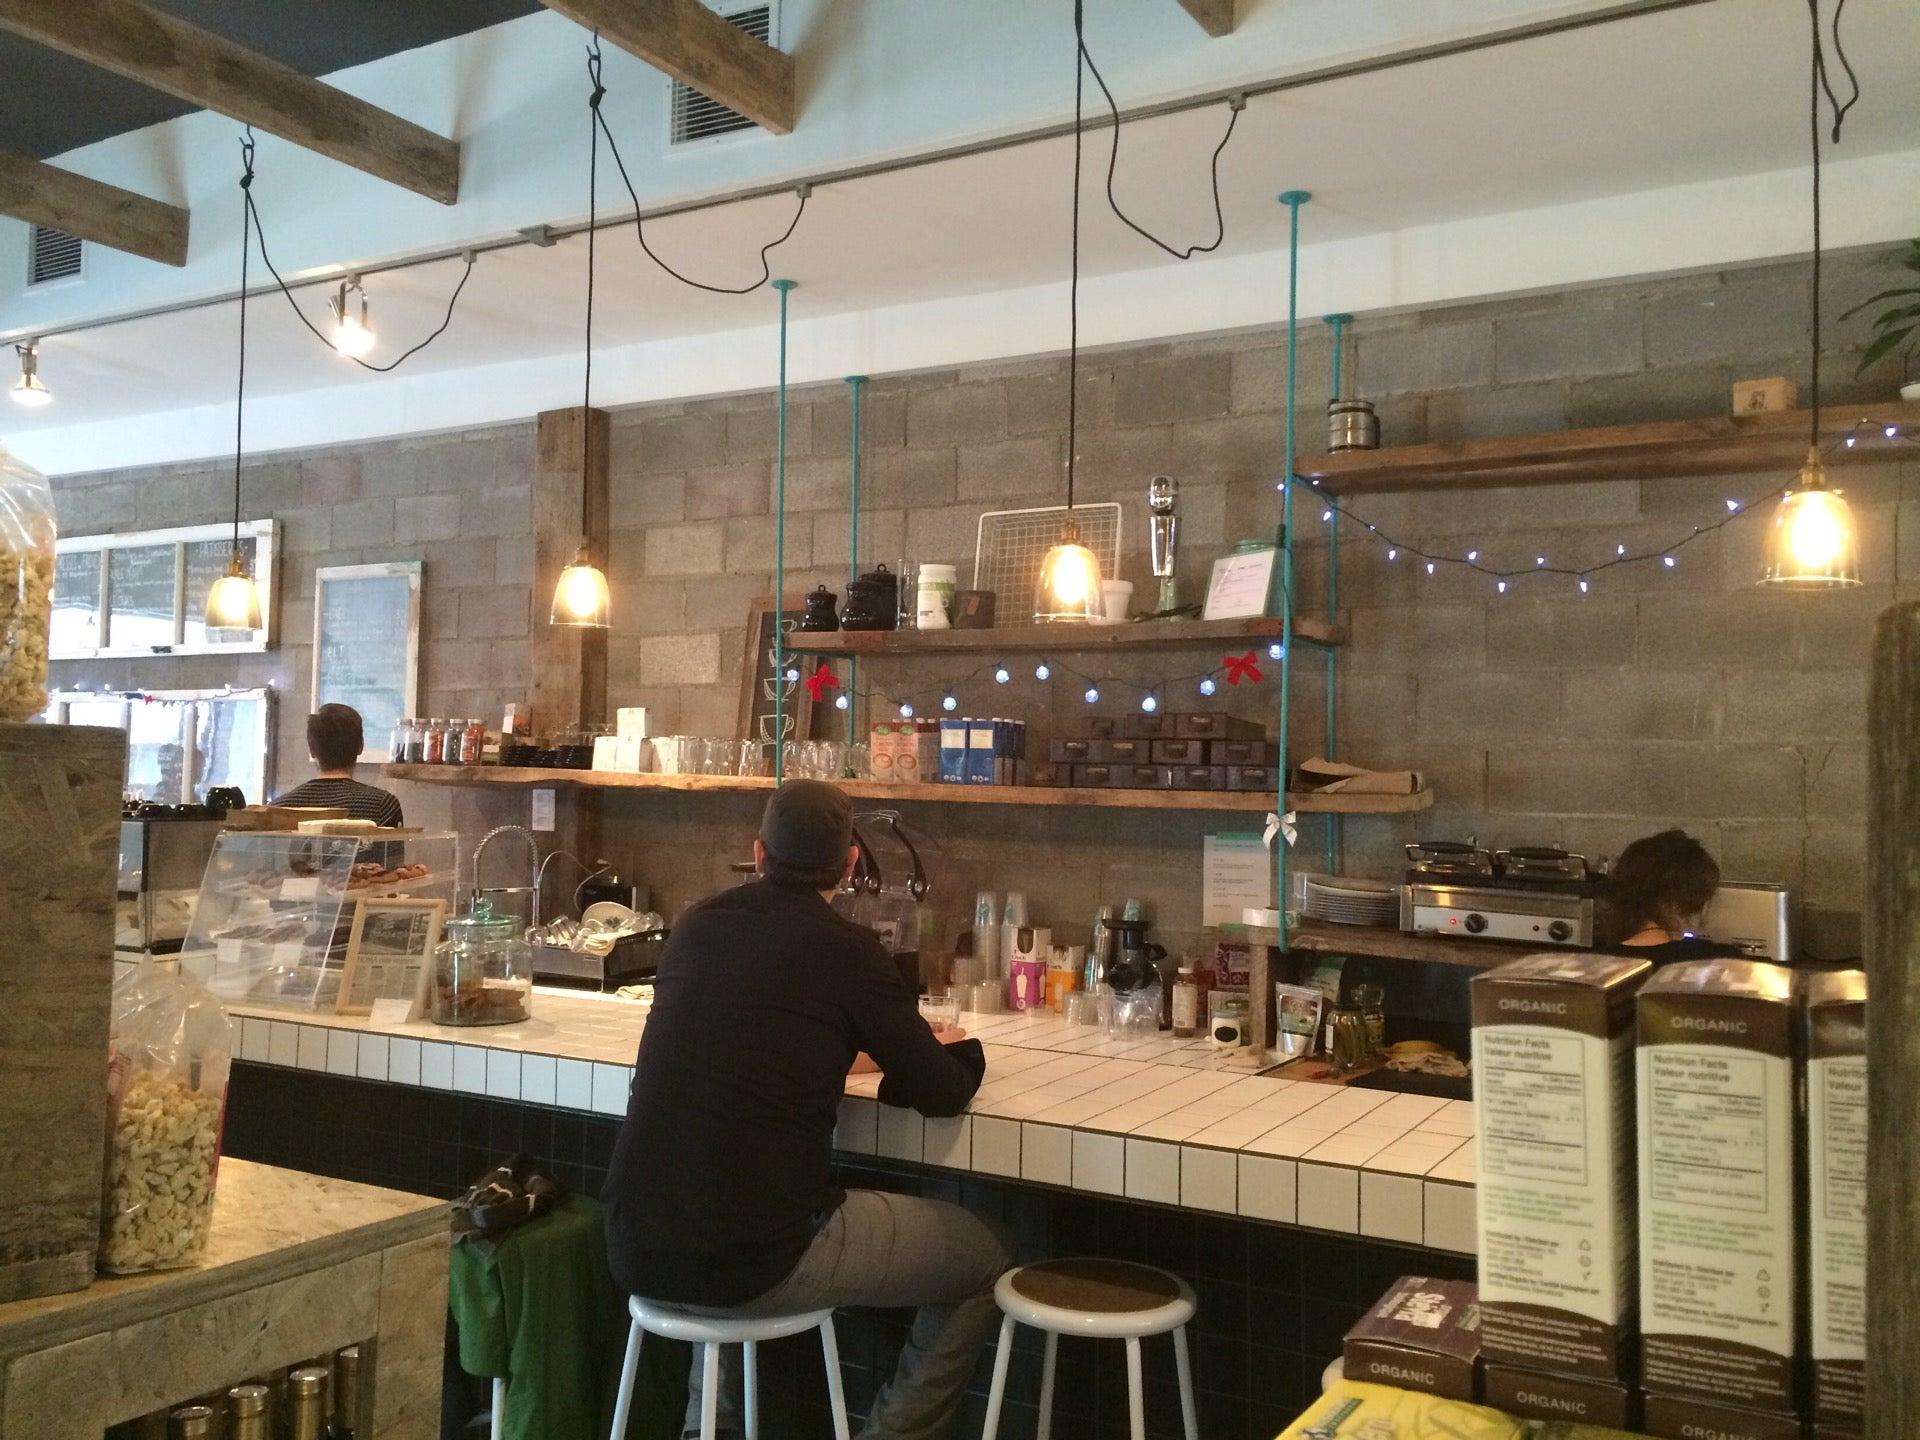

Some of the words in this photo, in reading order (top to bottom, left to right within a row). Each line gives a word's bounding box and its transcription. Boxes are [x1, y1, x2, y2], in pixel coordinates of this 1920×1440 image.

[1498, 998, 1568, 1015] ORGANIC
[1670, 1015, 1748, 1034] ORGANIC
[1485, 1035, 1522, 1047] Nutrition
[1525, 1038, 1551, 1049] Facts
[1653, 1054, 1697, 1067] Nutrition
[1701, 1058, 1728, 1070] Facts
[1654, 1067, 1685, 1079] Valeur
[1687, 1071, 1731, 1083] nutritive
[1370, 1361, 1435, 1385] ORGANIC
[1516, 1390, 1588, 1415] ORGANIC
